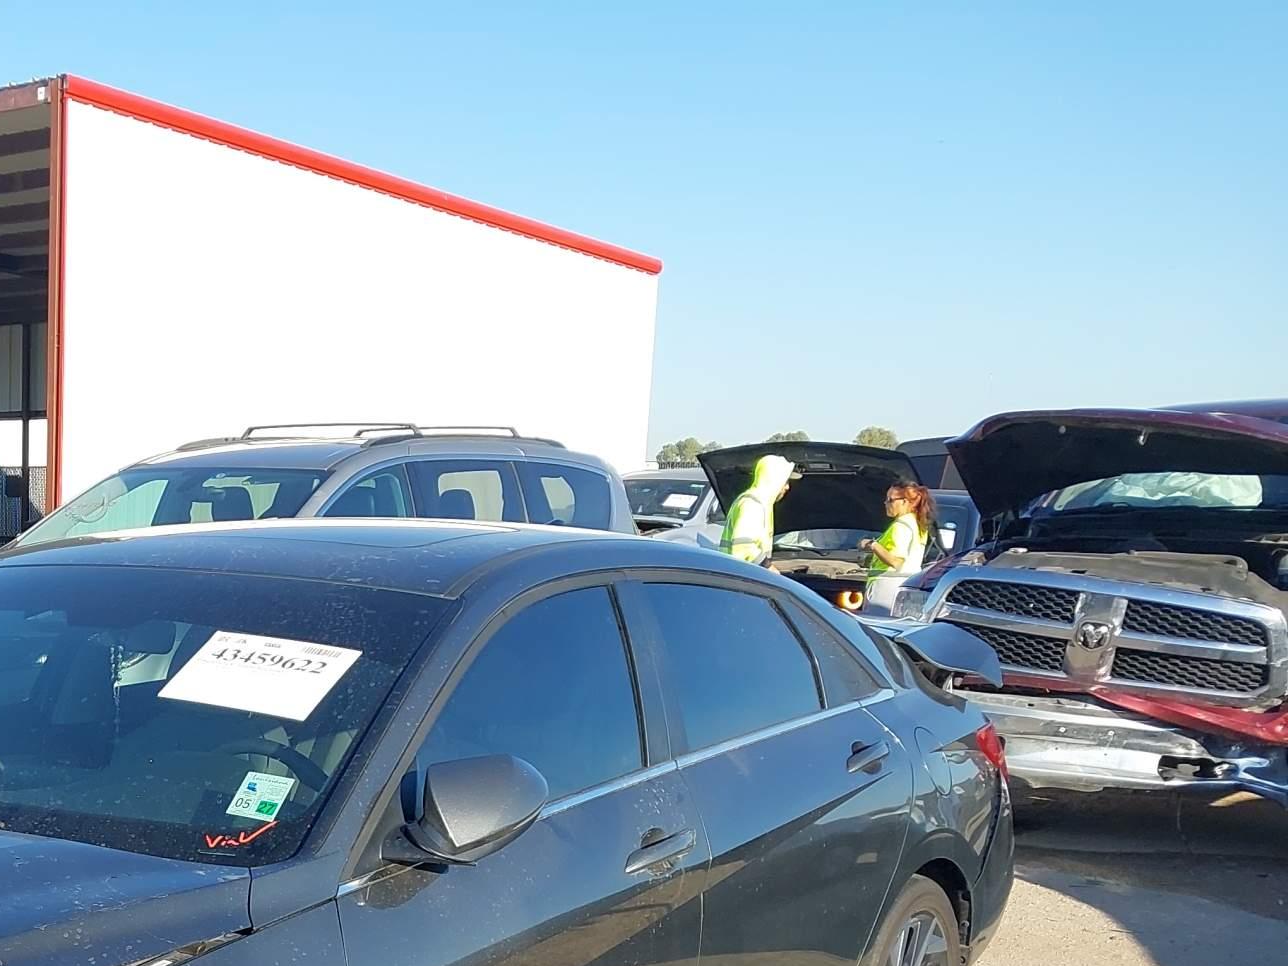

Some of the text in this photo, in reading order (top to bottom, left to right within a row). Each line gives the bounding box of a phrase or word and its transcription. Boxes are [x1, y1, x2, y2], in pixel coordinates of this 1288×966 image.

[212, 648, 327, 674] 43459622
[234, 797, 275, 815] 05 27
